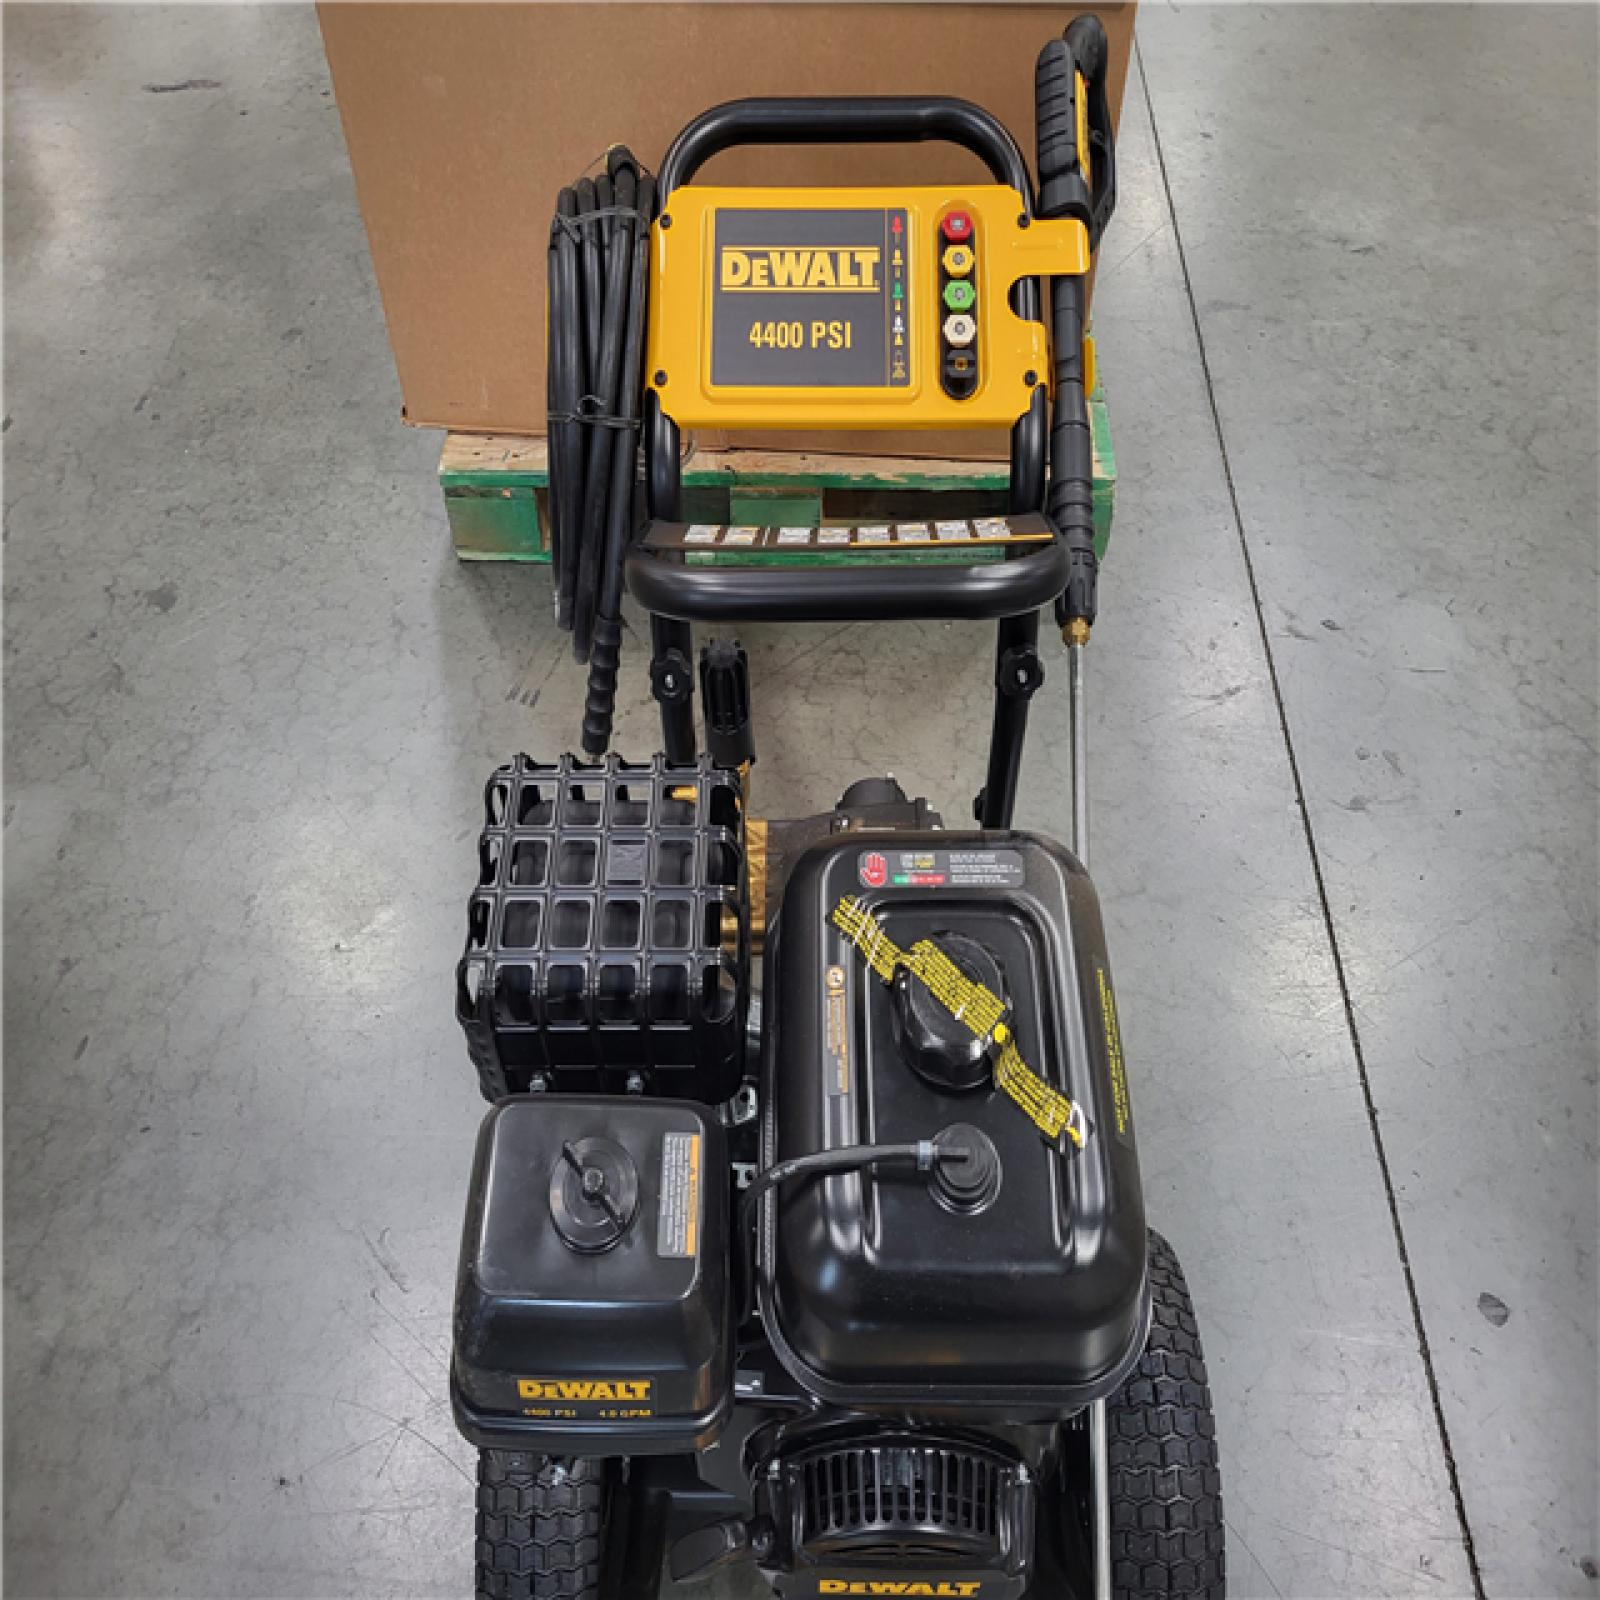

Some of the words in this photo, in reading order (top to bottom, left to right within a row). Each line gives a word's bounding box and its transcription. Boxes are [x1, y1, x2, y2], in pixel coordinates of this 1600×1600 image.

[722, 250, 880, 287] DEWALT
[750, 321, 803, 348] 4400
[811, 321, 851, 349] PSI
[518, 1380, 650, 1400] DEWALT
[819, 1580, 981, 1597] DEWALT
